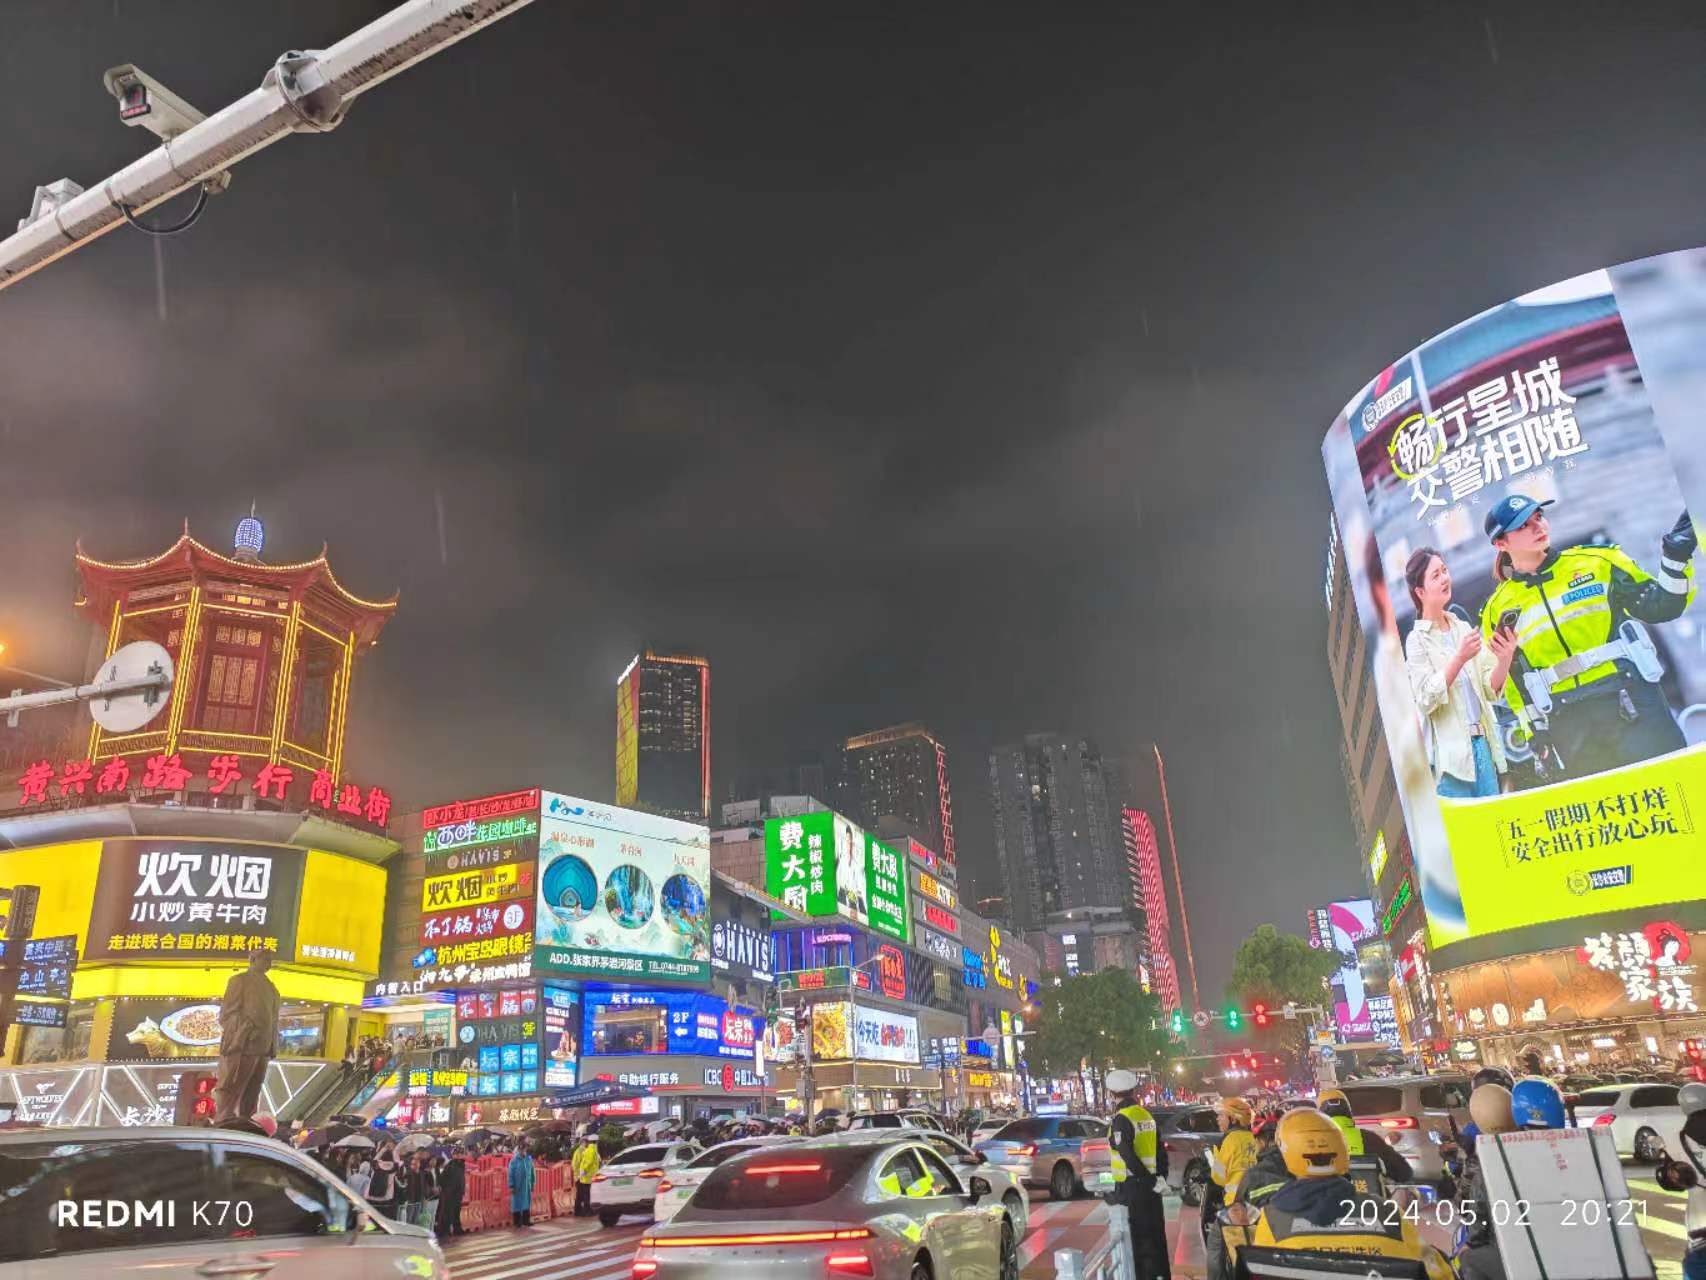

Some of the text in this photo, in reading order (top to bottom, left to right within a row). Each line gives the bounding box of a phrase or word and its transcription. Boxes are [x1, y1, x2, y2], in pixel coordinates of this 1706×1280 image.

[1397, 356, 1577, 474] 畅行星城
[1407, 407, 1589, 521] 交警相随
[18, 753, 391, 828] 黄兴南路步行商业街
[1507, 786, 1670, 840] 五一假期不打烊
[1511, 811, 1678, 863] 安全出行放心玩
[134, 852, 272, 899] 炊烟
[460, 847, 500, 867] HAVIS
[780, 821, 808, 912] 费大厨
[428, 876, 481, 906] 炊烟
[131, 902, 267, 925] 小炒黄牛肉
[437, 935, 524, 965] 杭州宝岛眼镜
[673, 1012, 690, 1023] 2F
[618, 1073, 680, 1086] 自助银行服务
[704, 1068, 721, 1085] ICBC
